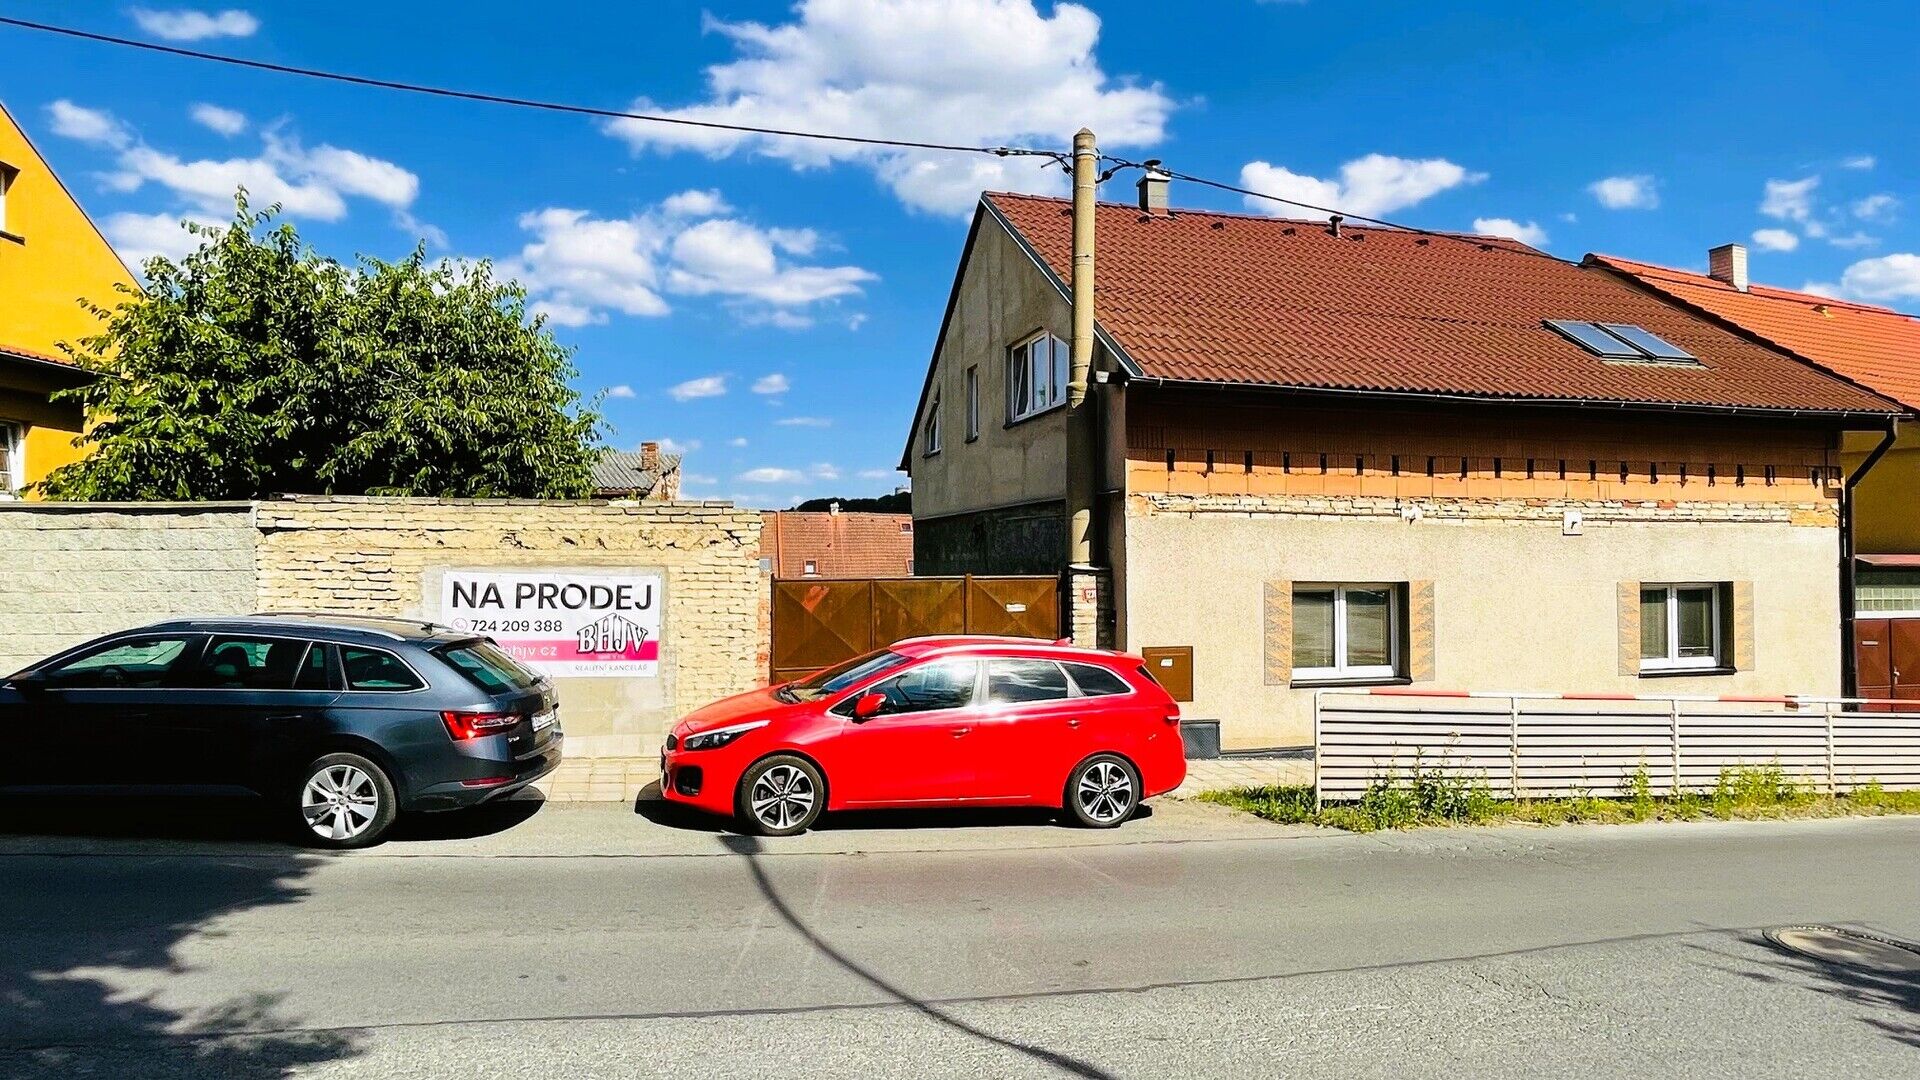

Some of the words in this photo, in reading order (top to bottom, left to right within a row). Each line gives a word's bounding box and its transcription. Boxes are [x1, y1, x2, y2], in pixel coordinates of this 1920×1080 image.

[452, 580, 505, 609] NA
[515, 582, 652, 610] PRODEJ
[471, 619, 497, 632] 724
[502, 620, 530, 632] 209
[534, 620, 563, 632] 388
[576, 612, 649, 655] BHJV
